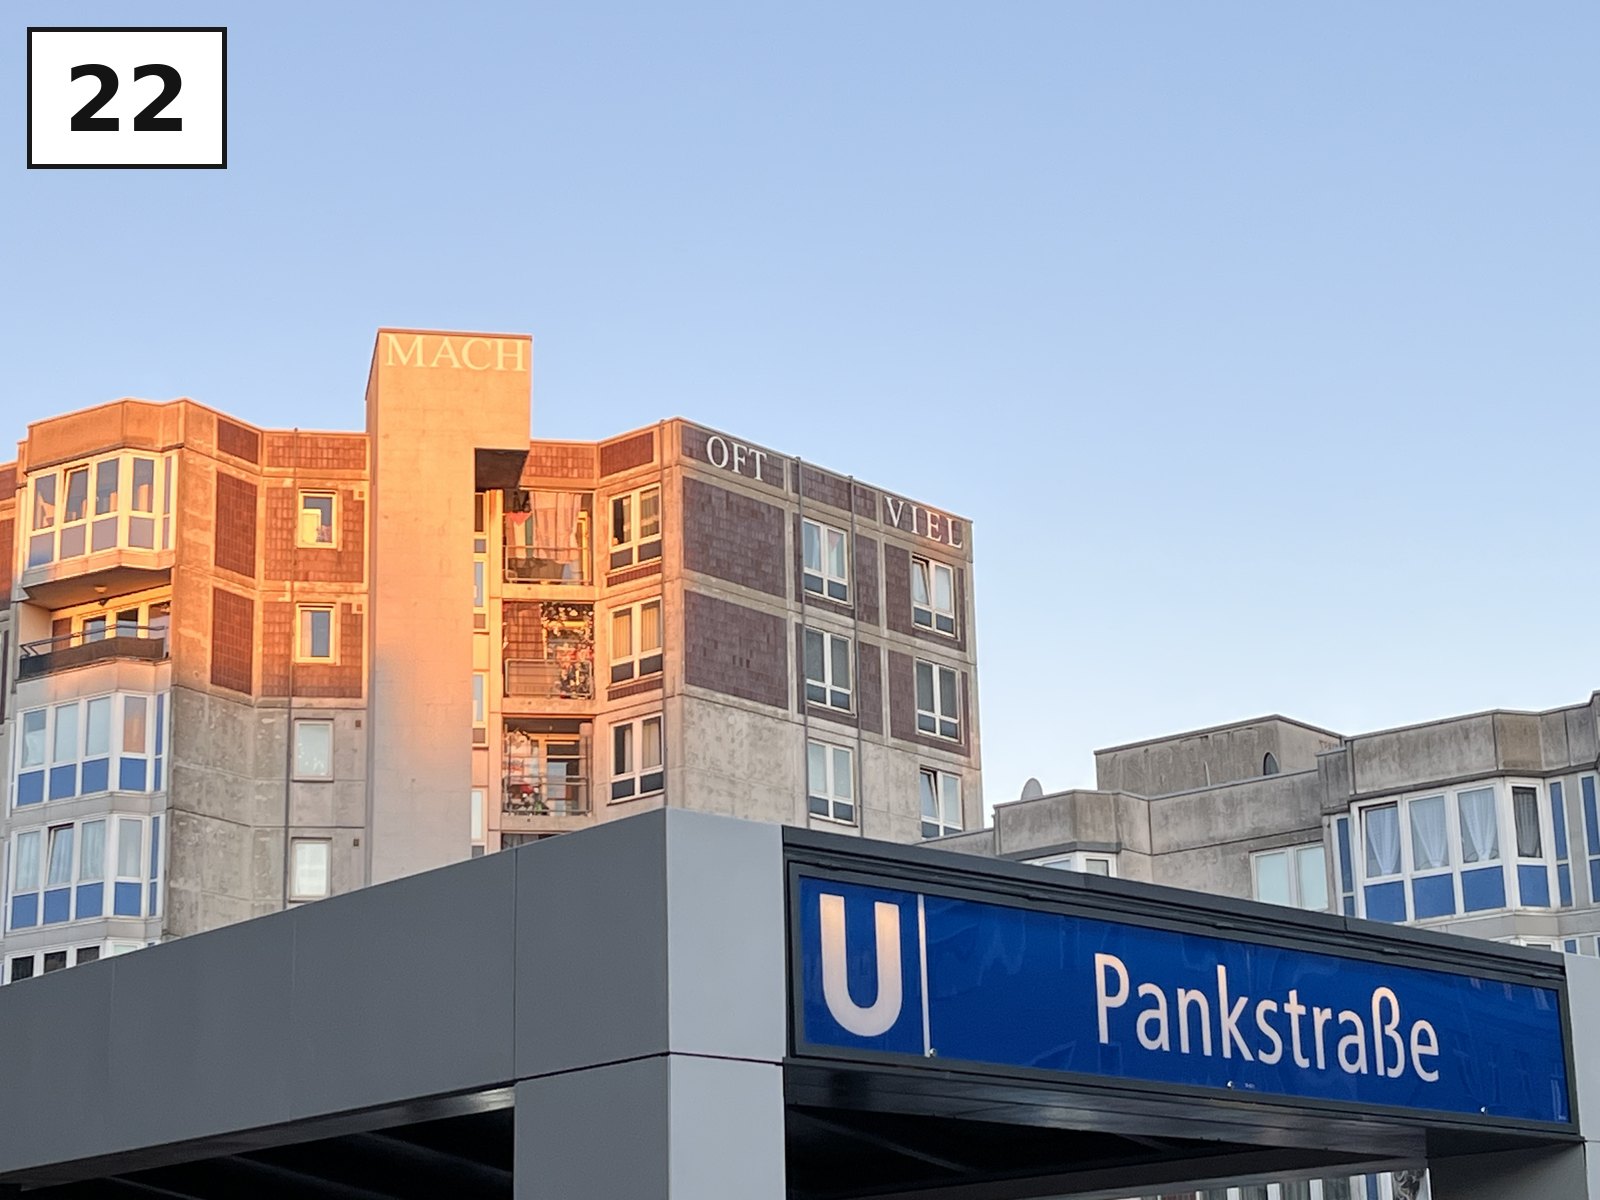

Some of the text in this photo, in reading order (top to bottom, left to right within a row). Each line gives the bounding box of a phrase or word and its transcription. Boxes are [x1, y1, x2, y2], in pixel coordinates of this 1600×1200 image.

[385, 334, 527, 372] MACH
[706, 435, 962, 549] OFT VIEL
[819, 893, 1440, 1083] U Pankstraße
